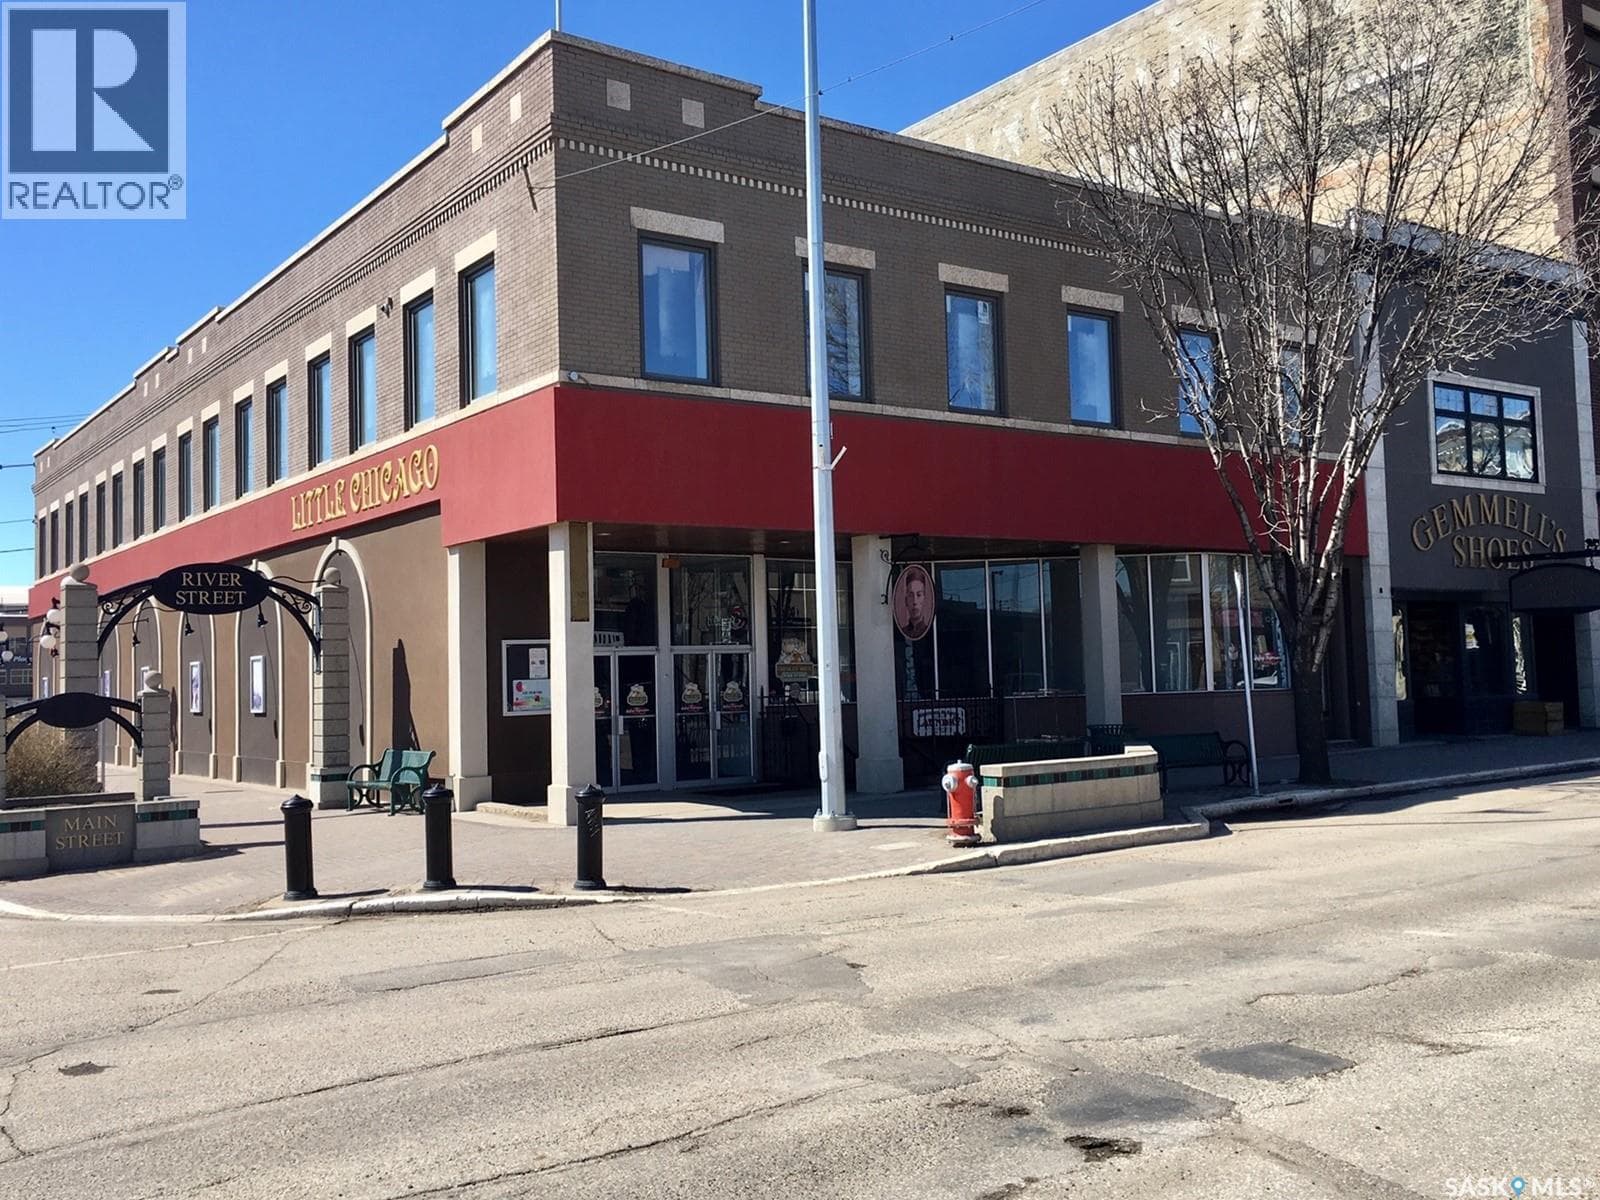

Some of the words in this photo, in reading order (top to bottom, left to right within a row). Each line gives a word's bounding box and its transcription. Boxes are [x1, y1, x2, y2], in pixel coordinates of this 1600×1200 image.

[291, 478, 347, 531] LITTLE
[349, 444, 439, 513] CHICAGO
[1412, 493, 1567, 553] GEMMELL'S
[1453, 535, 1534, 570] SHOES
[181, 572, 243, 586] RIVER
[175, 590, 247, 605] STREET
[64, 814, 118, 832] MAIN
[55, 832, 125, 850] STREET
